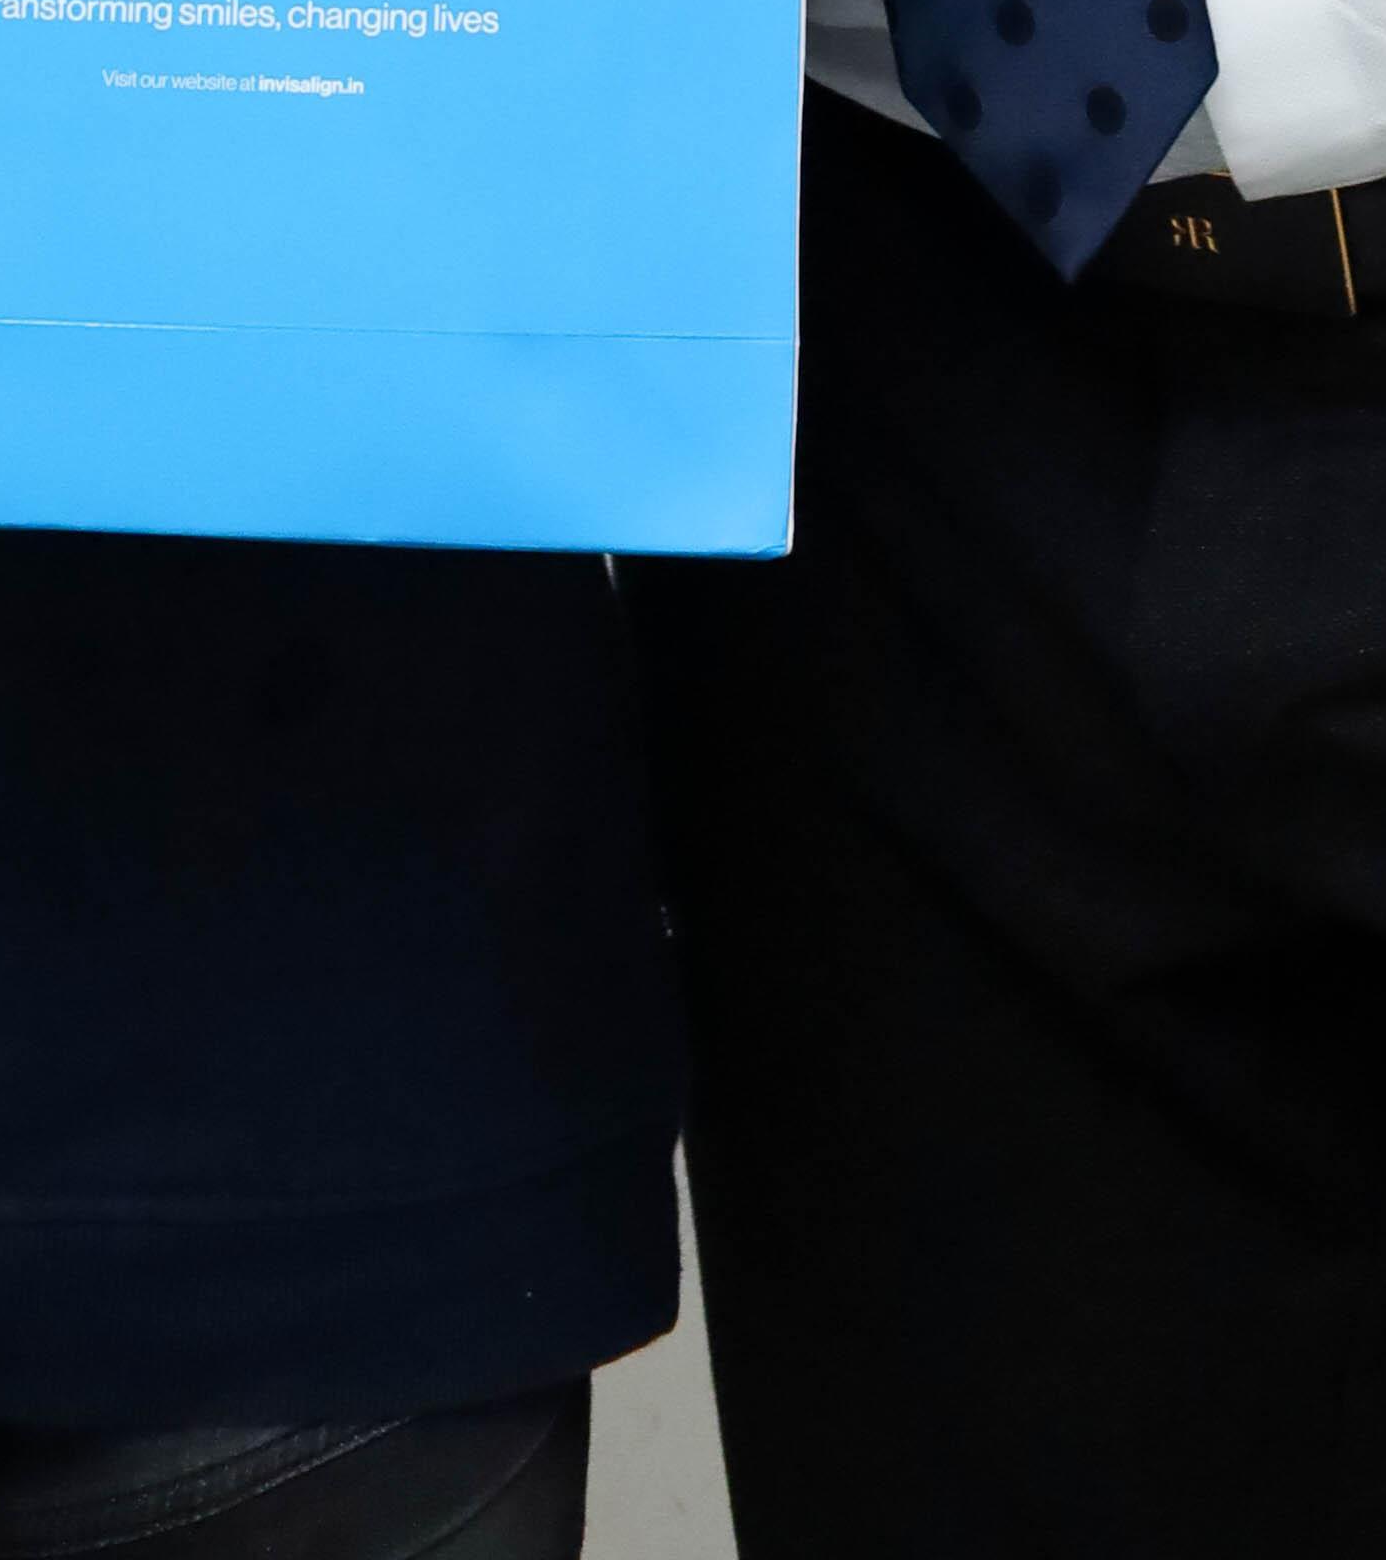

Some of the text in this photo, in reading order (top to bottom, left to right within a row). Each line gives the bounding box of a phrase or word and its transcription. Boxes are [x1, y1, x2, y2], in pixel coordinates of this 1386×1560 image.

[287, 0, 428, 38] changing
[433, 3, 500, 34] lives
[102, 69, 365, 98] Visit our website at invisalign.in
